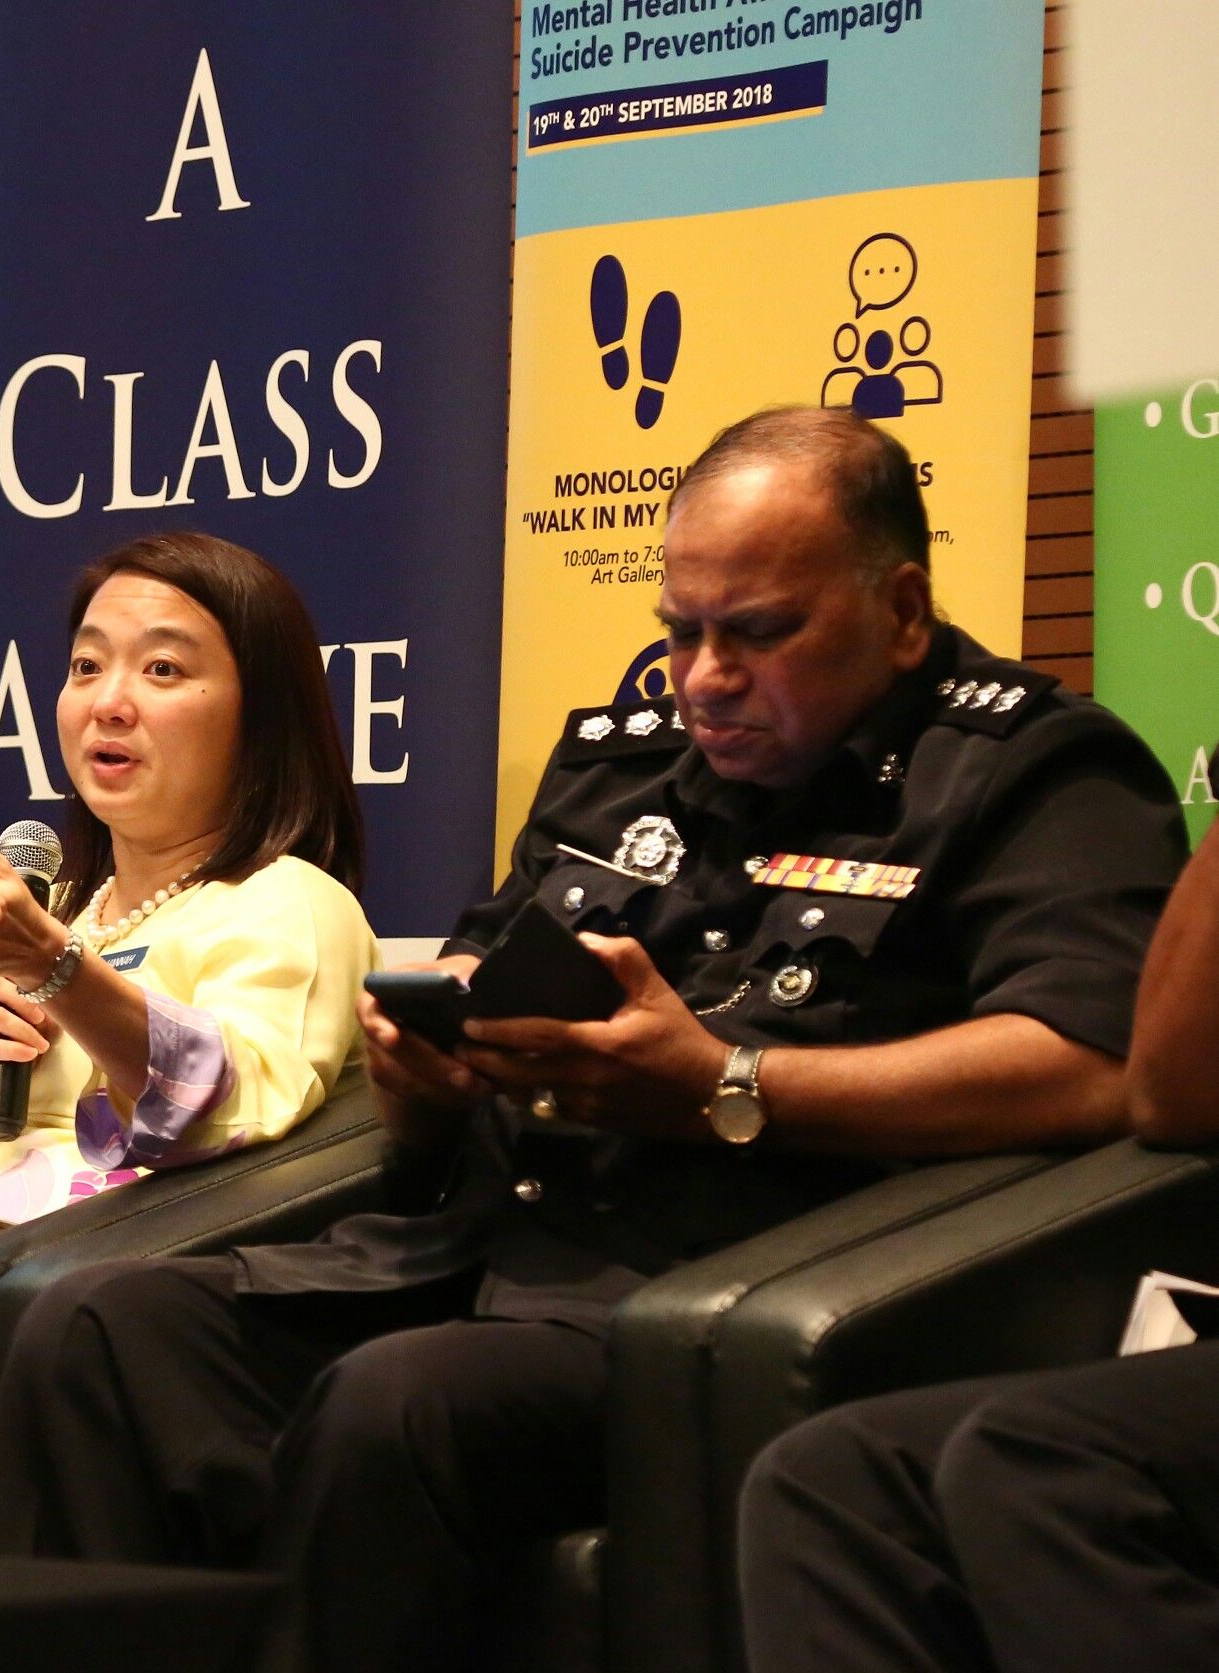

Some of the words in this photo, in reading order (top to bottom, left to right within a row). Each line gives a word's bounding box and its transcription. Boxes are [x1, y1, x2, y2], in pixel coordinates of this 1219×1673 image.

[532, 0, 612, 38] Mental
[530, 34, 614, 80] Suicide
[623, 16, 776, 64] Prevention
[784, 0, 923, 40] Campaign
[533, 111, 560, 136] 19TH
[563, 109, 576, 131] &
[579, 103, 614, 128] 20TH
[618, 90, 728, 124] SEPTEMBER
[732, 83, 773, 109] 2018
[145, 47, 251, 222] A
[592, 505, 616, 530] IN
[623, 502, 661, 528] MY
[563, 549, 619, 568] 10:00am
[623, 549, 639, 564] to
[591, 567, 613, 585] Art
[618, 564, 665, 587] Gallery
